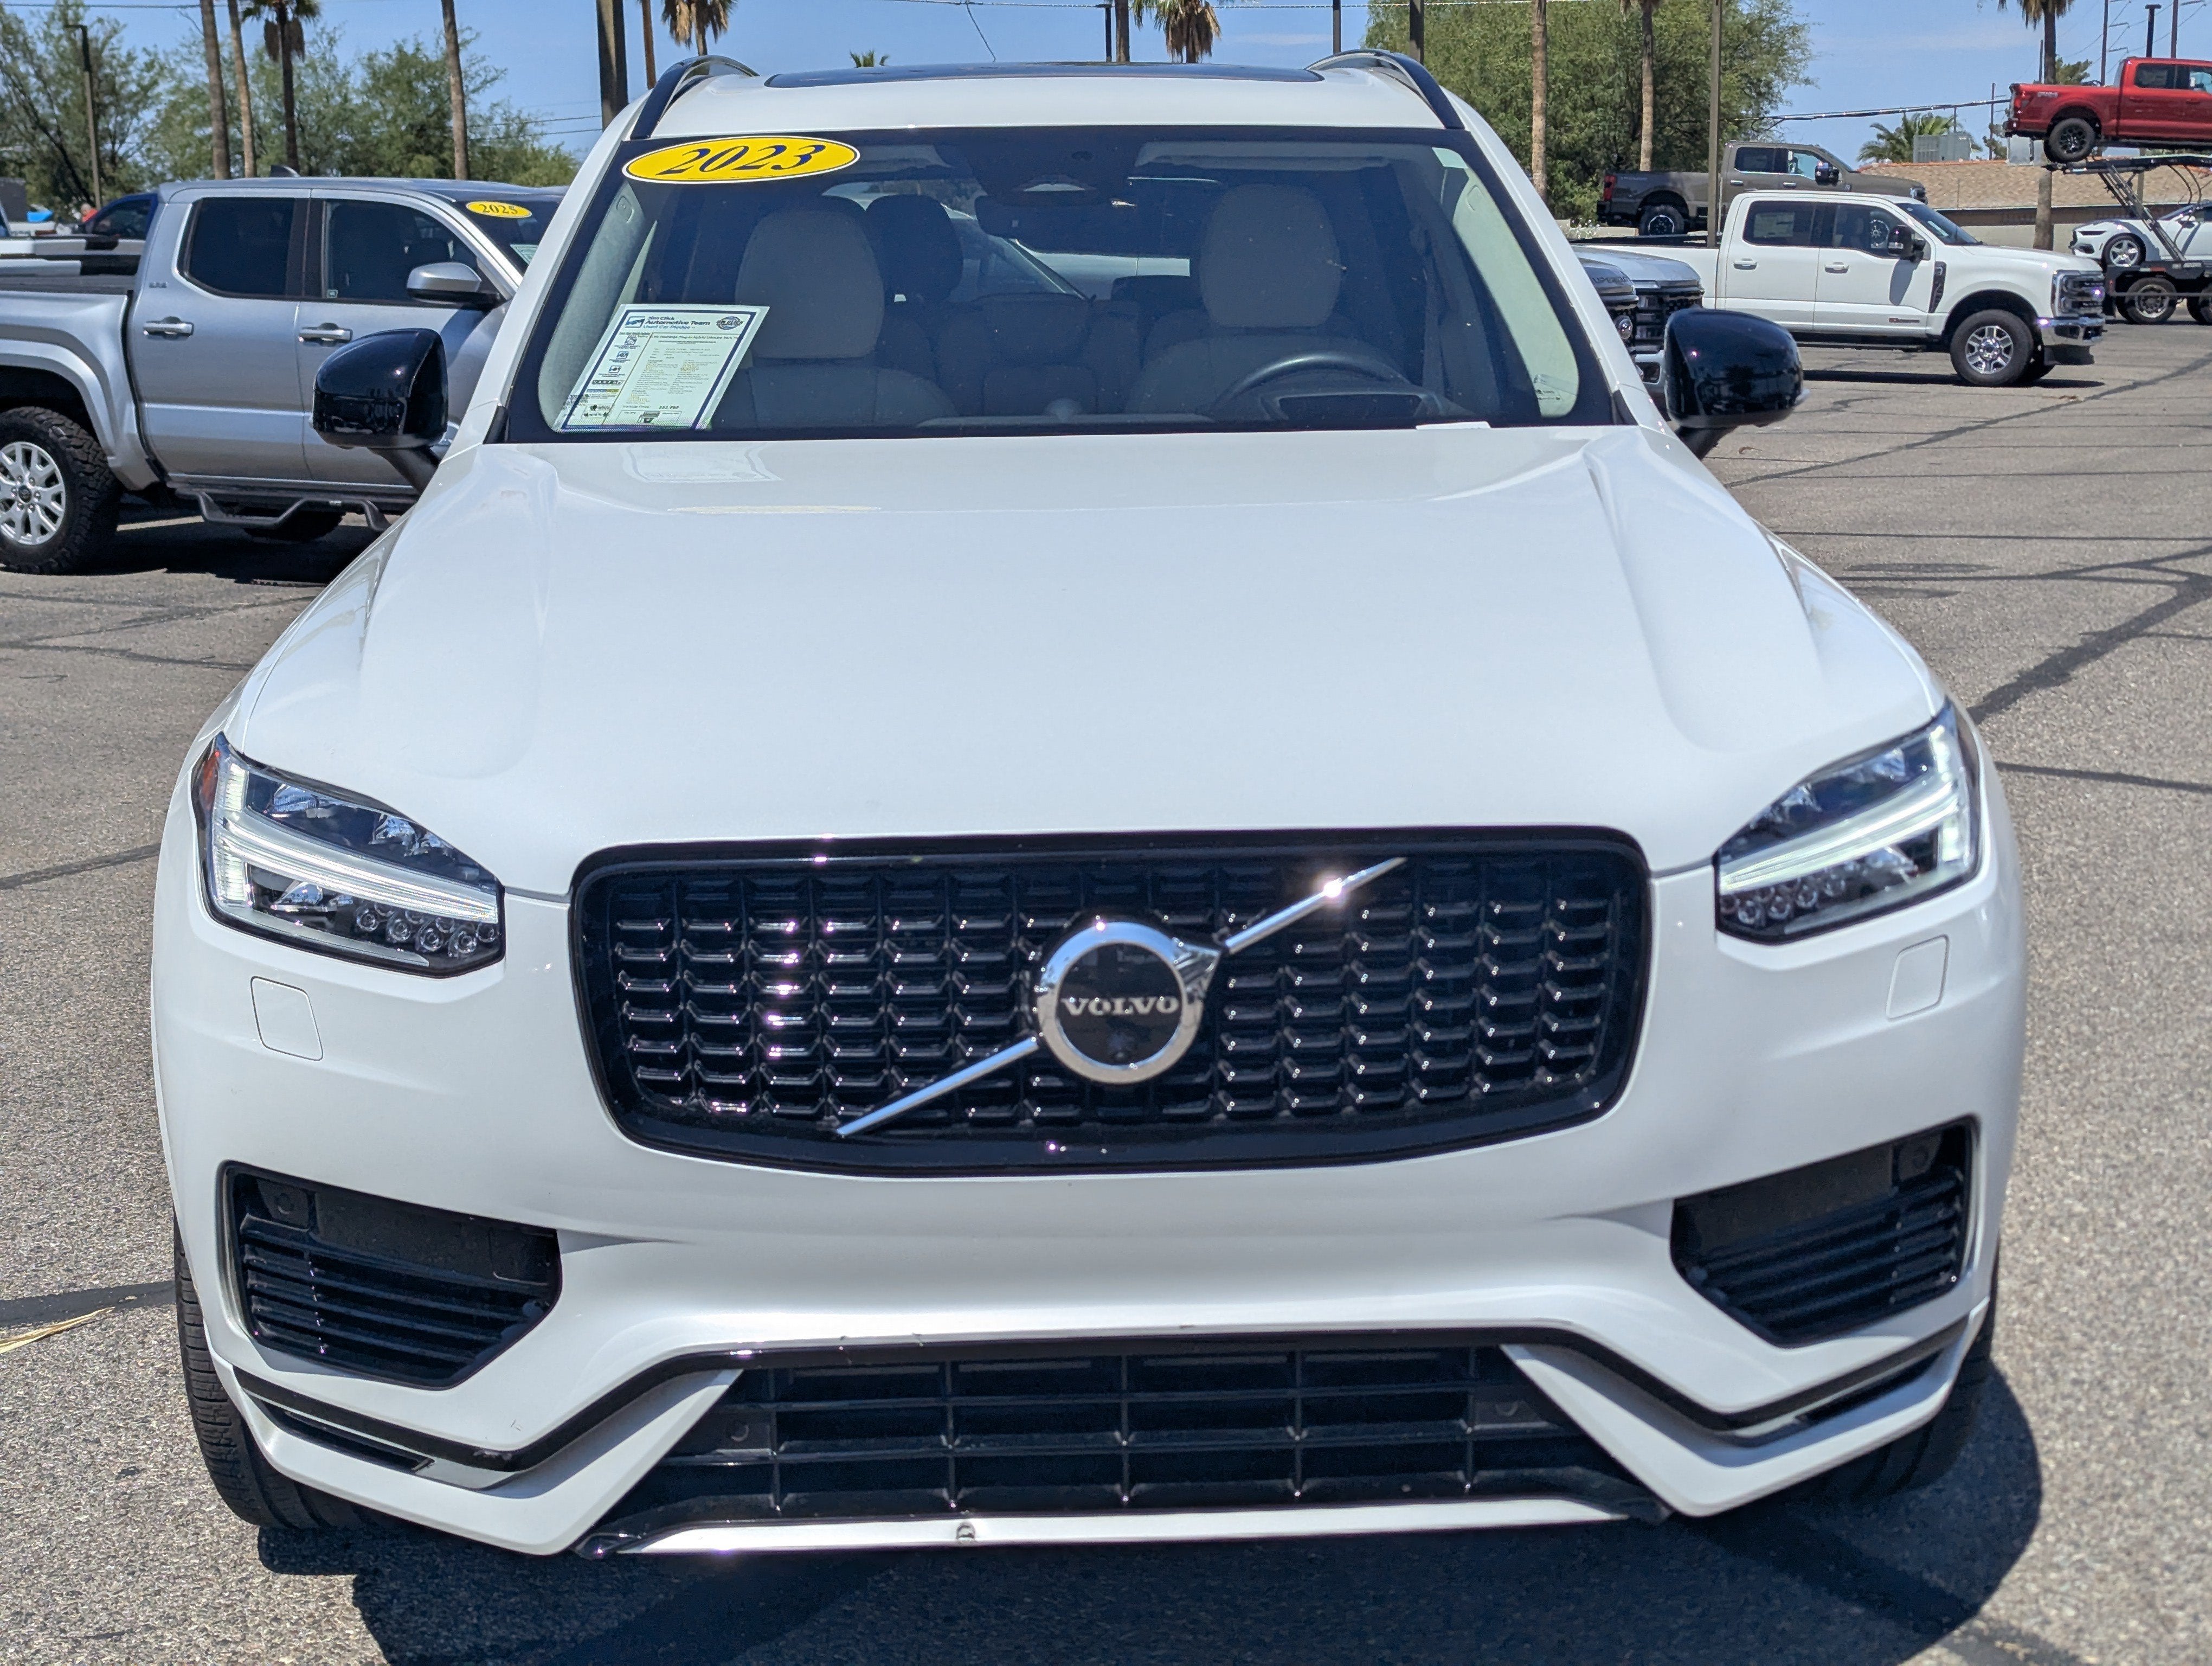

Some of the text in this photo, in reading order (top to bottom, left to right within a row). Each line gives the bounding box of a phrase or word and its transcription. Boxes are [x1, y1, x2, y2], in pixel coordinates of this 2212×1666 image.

[655, 144, 826, 176] 2023
[478, 204, 518, 214] 2025
[1060, 996, 1180, 1016] VOLVO
